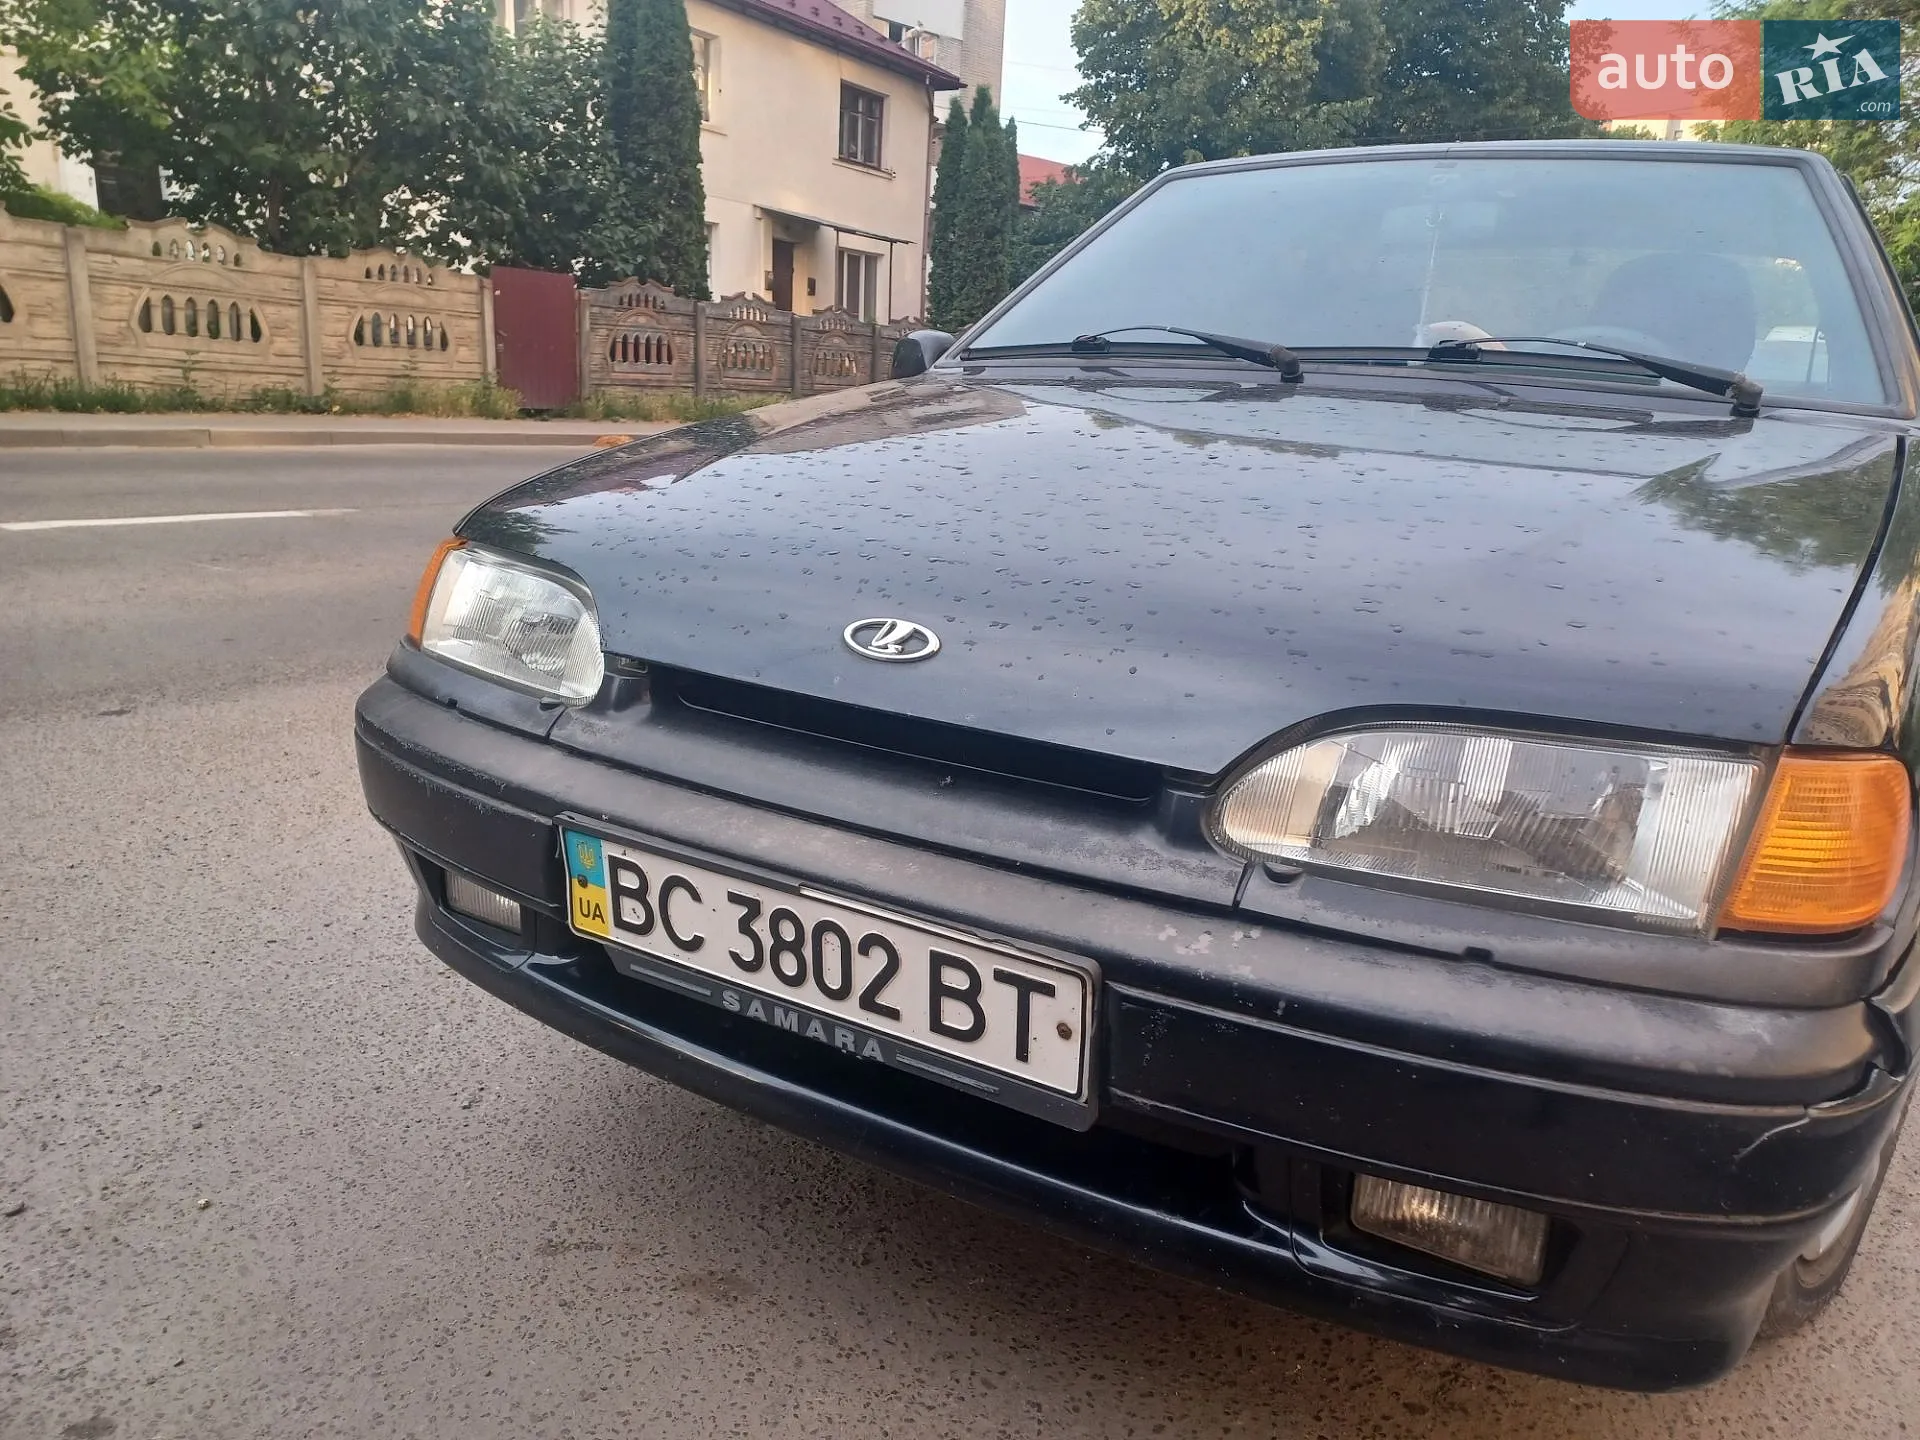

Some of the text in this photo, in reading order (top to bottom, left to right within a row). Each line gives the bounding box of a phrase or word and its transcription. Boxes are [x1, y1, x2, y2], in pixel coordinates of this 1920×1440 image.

[579, 898, 606, 925] UA
[606, 853, 1057, 1063] BC 3802 BT
[721, 989, 886, 1063] SAMARA
